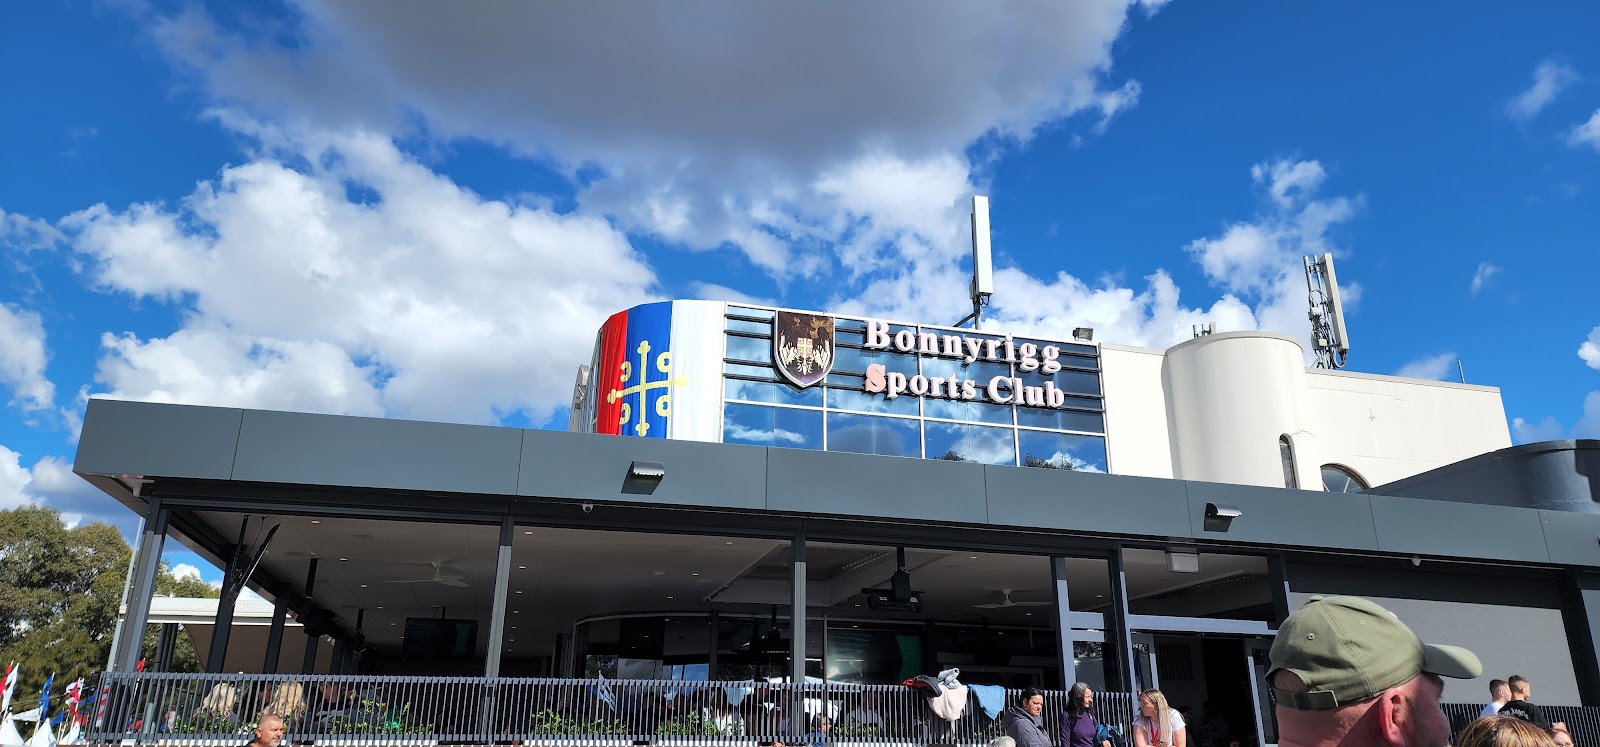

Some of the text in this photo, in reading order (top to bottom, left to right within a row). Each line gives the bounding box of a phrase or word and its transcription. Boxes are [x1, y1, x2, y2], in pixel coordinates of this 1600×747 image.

[864, 319, 1062, 373] Bonnyrigg
[865, 363, 1065, 408] Sports Club
